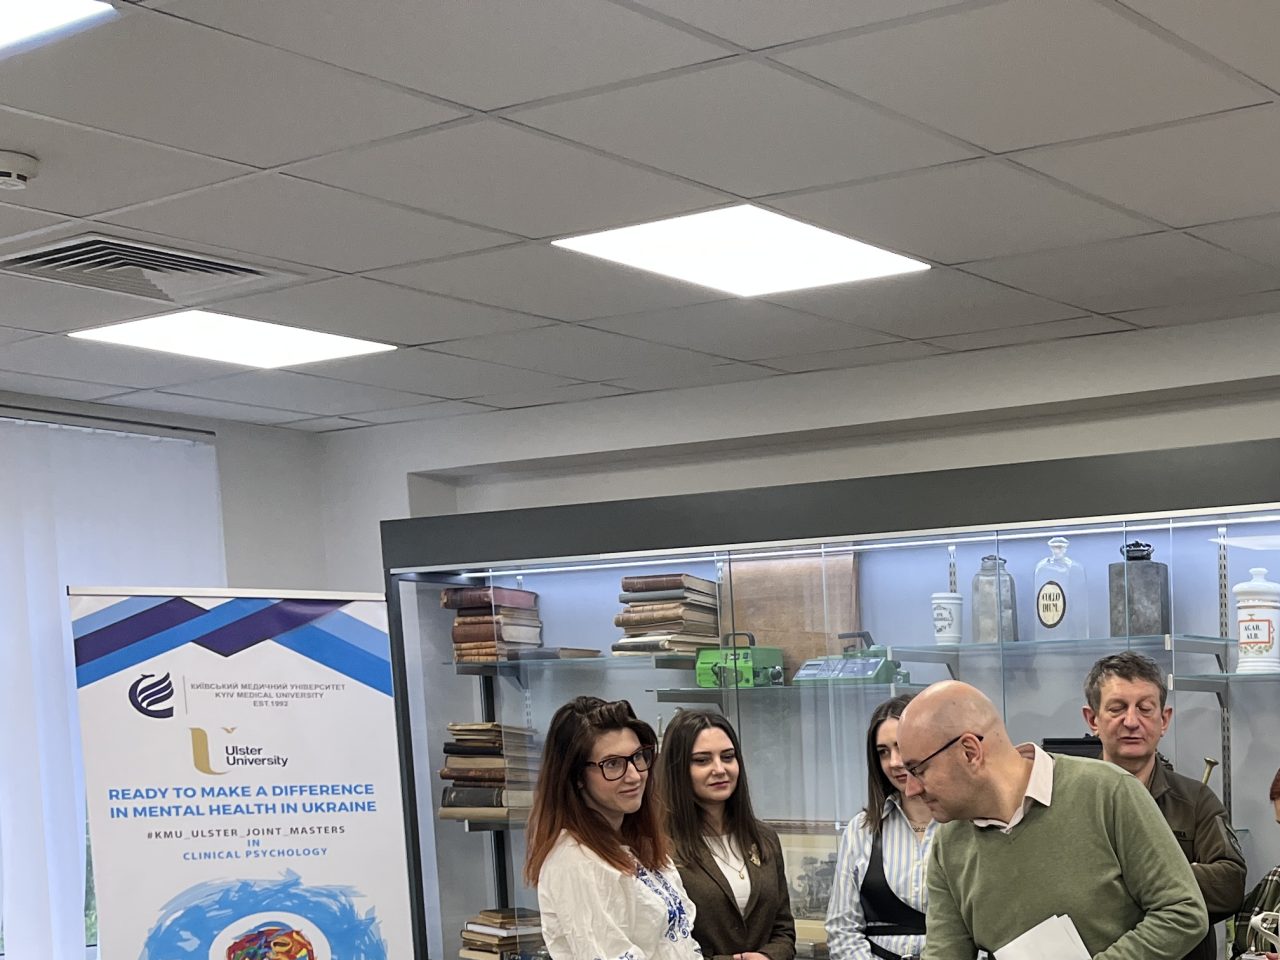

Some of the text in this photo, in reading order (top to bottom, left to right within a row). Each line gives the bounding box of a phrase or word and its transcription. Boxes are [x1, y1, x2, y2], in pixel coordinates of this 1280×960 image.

[190, 682, 239, 690] КИЇВСЬКИЙ
[240, 683, 288, 691] МЕДИЧНИЙ
[225, 745, 263, 756] Ulster
[226, 755, 289, 768] University
[109, 784, 375, 800] READY TO MAKE A DIFFERENCE
[110, 801, 377, 818] IN MENTAL HEALTH IN UKRAINE
[247, 839, 260, 847] IN
[183, 848, 327, 861] CLINICAL PSYCHOLOGY
